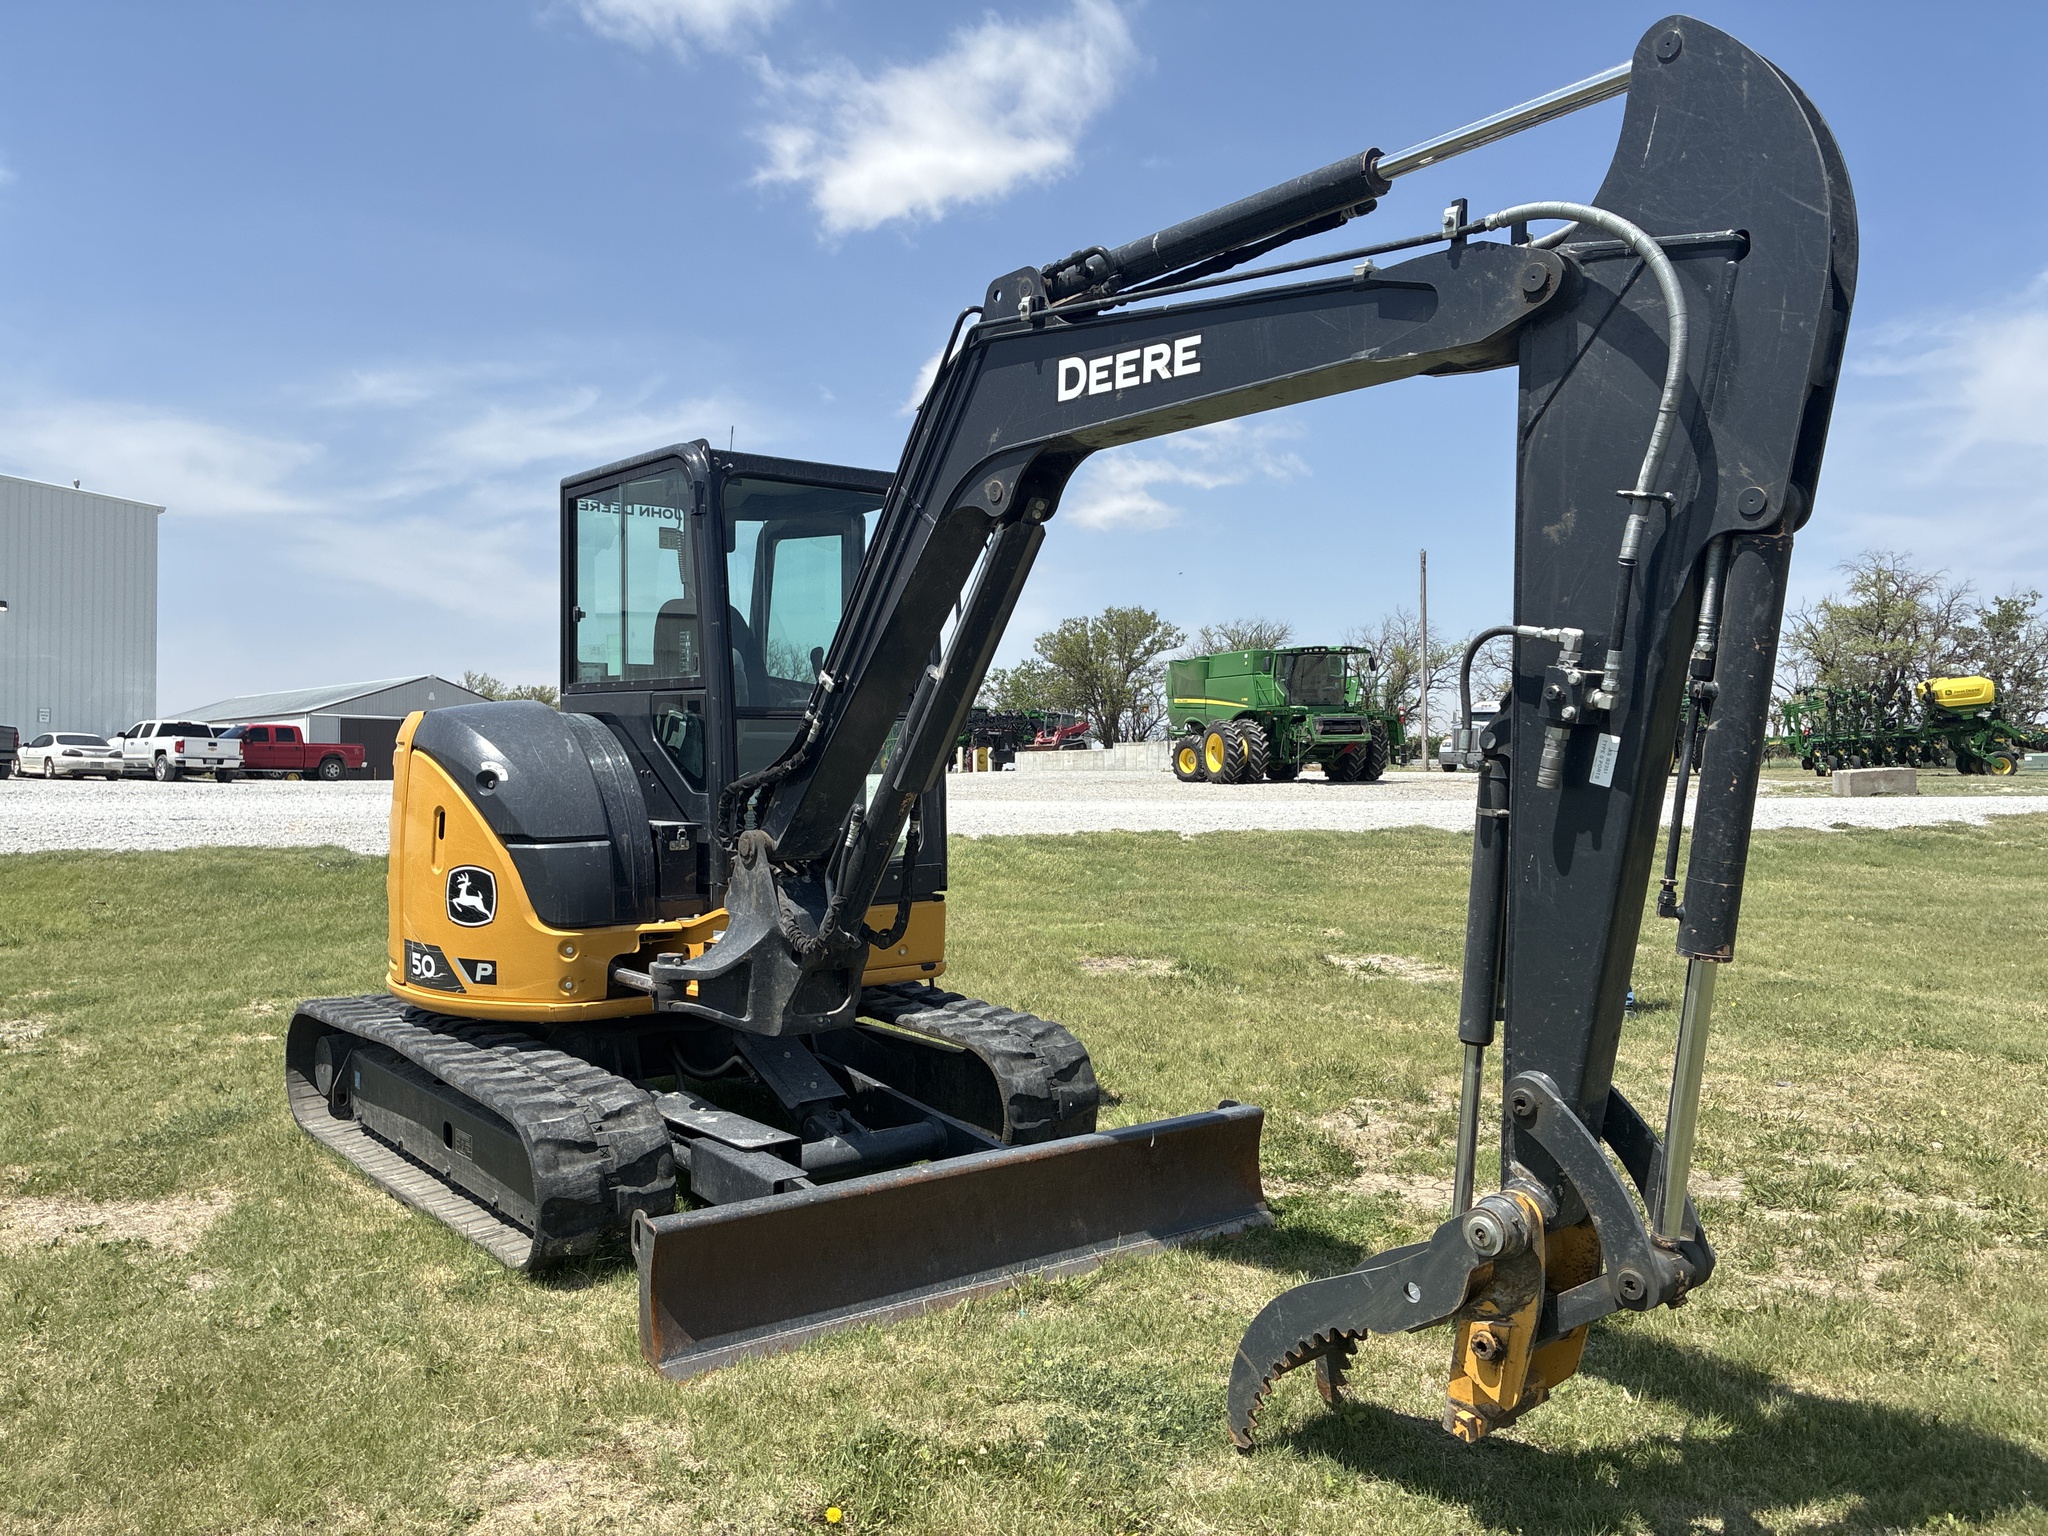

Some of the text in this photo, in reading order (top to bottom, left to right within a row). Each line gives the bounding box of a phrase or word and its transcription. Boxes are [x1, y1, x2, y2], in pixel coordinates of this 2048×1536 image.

[1058, 334, 1202, 402] DEERE
[412, 952, 435, 978] 50
[475, 963, 493, 981] P
